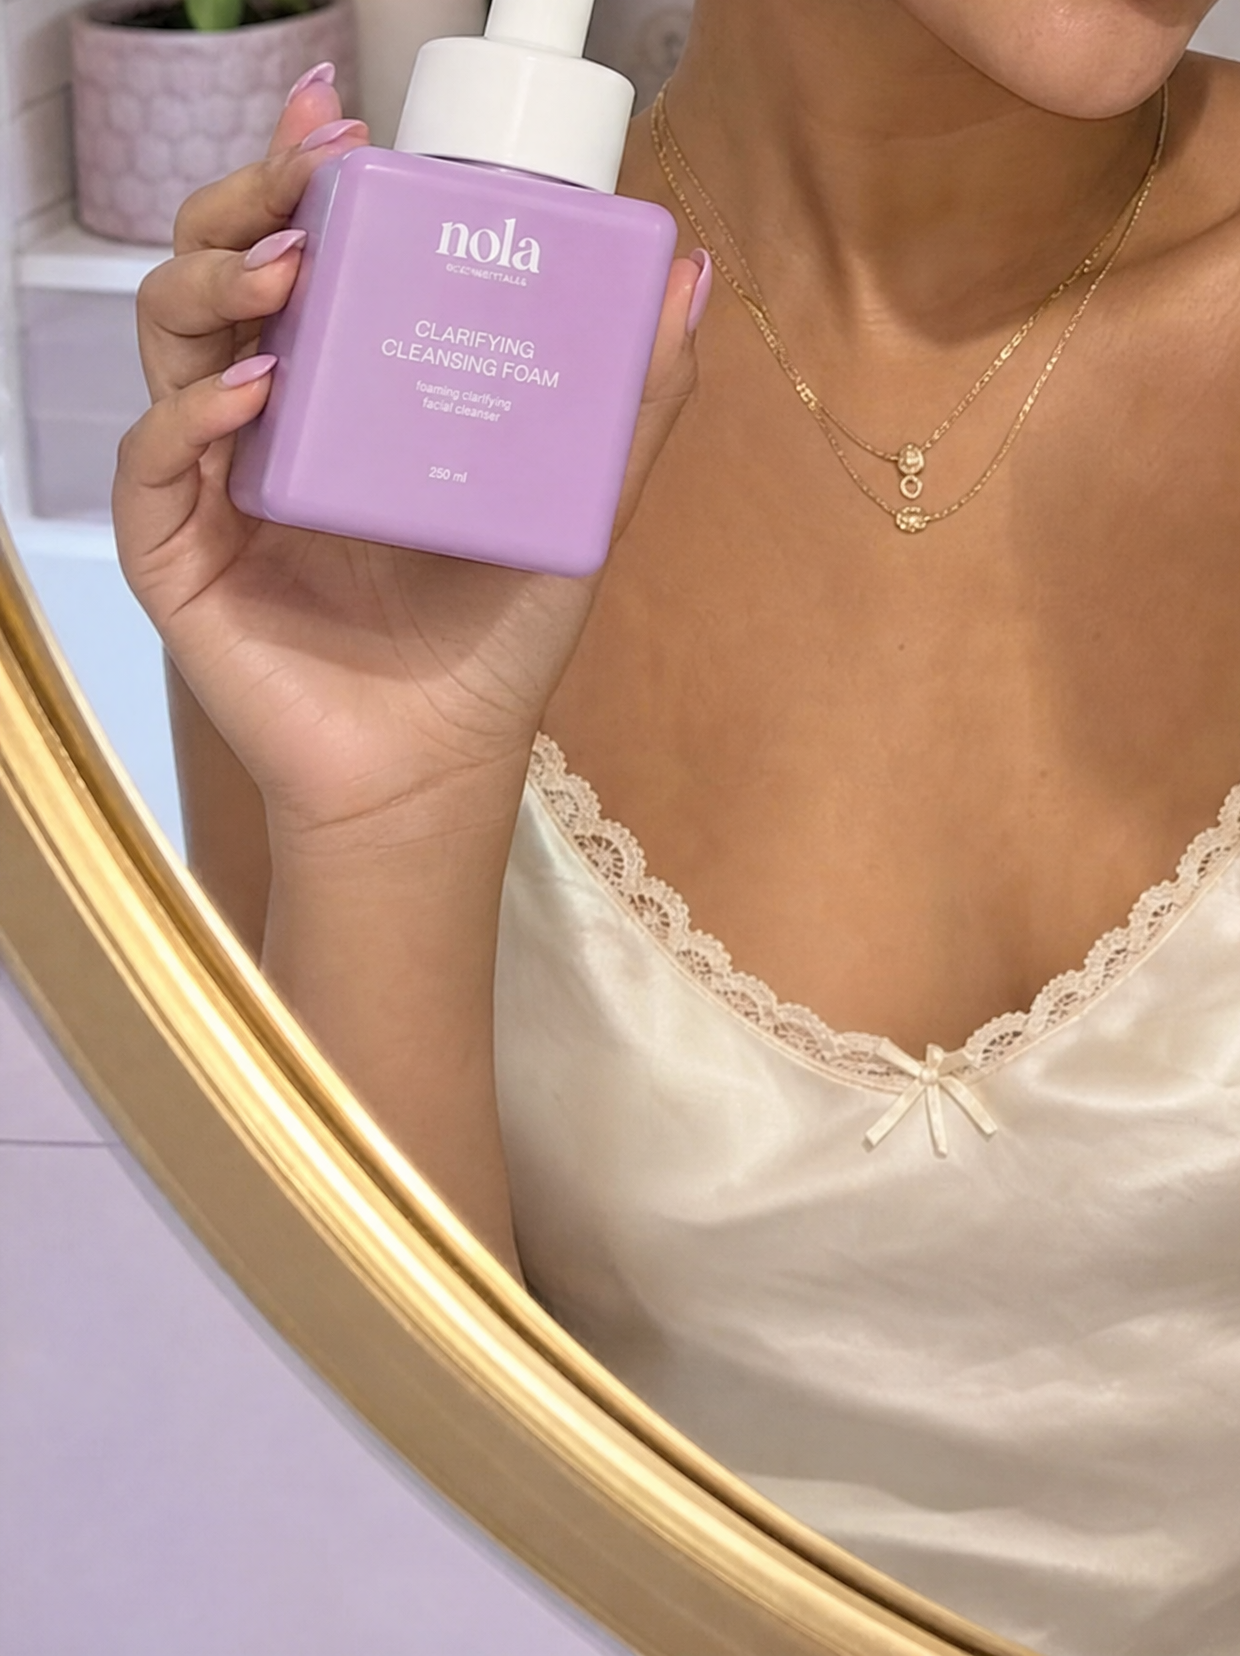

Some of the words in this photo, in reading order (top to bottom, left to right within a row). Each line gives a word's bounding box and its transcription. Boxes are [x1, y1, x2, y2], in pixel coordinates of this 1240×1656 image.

[436, 218, 541, 274] nola
[415, 320, 535, 359] CLARIFYING
[381, 338, 497, 377] CLEANSING
[502, 362, 559, 388] FOAM
[415, 380, 460, 401] foaming
[462, 391, 512, 412] clarifying
[422, 396, 454, 413] facial
[455, 404, 501, 422] cleanser
[429, 466, 450, 481] 250
[453, 471, 467, 483] ml
